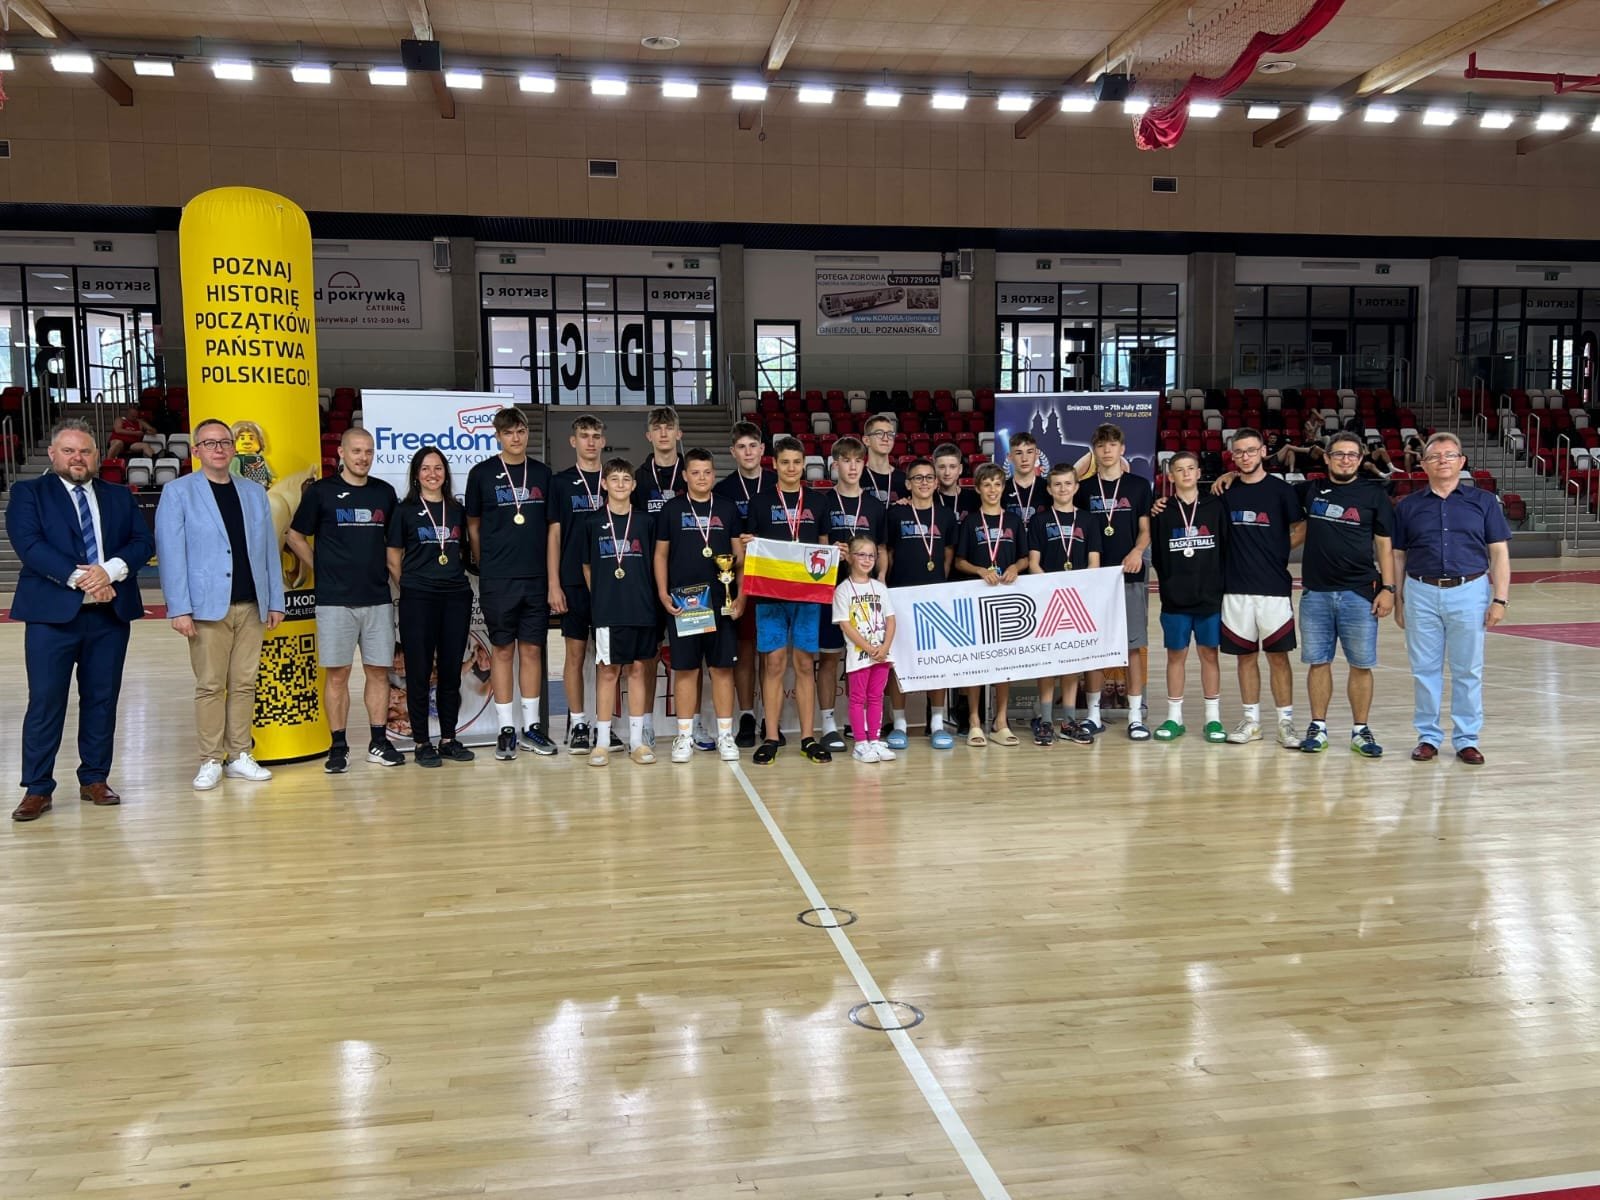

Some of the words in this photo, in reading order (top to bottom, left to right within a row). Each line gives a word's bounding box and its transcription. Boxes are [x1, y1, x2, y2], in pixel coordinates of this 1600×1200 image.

[213, 257, 292, 283] POZNAJ
[206, 284, 299, 311] HISTORIĘ
[328, 288, 405, 304] pokrywką
[366, 304, 406, 312] CATERING
[195, 311, 310, 334] POCZĄTKÓW
[206, 335, 305, 360] PAŃSTWA
[201, 366, 310, 386] POLSKIEGO!
[461, 413, 496, 425] SCHOO
[375, 426, 501, 451] Freedom
[376, 454, 412, 464] KURS
[336, 508, 385, 523] NBA
[1230, 510, 1270, 523] NBA
[1310, 500, 1361, 522] NBA
[1169, 538, 1216, 548] BASKETBALL
[912, 587, 1097, 651] NBA
[917, 652, 969, 666] FUNDACJA
[970, 646, 1017, 661] NIESOBSKI
[1018, 642, 1052, 655] BASKET
[1053, 638, 1099, 650] ACADEMY
